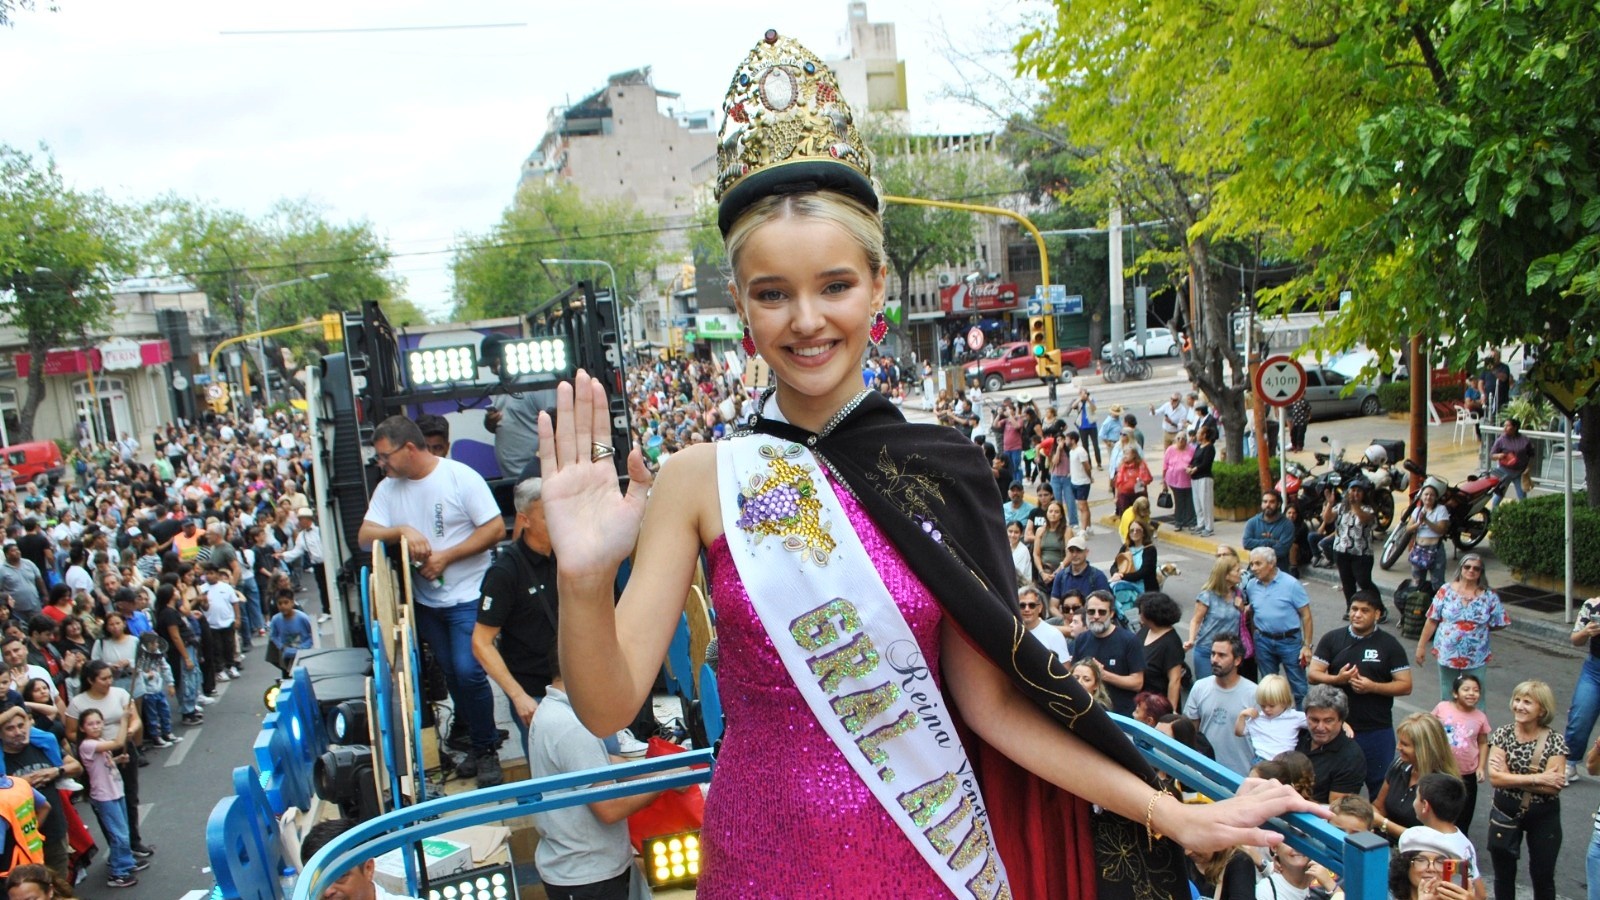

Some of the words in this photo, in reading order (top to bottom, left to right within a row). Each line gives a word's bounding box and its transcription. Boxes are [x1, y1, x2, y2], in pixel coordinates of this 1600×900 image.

[788, 597, 920, 784] GRAL.
[885, 639, 951, 749] Reina
[1364, 649, 1379, 659] DG
